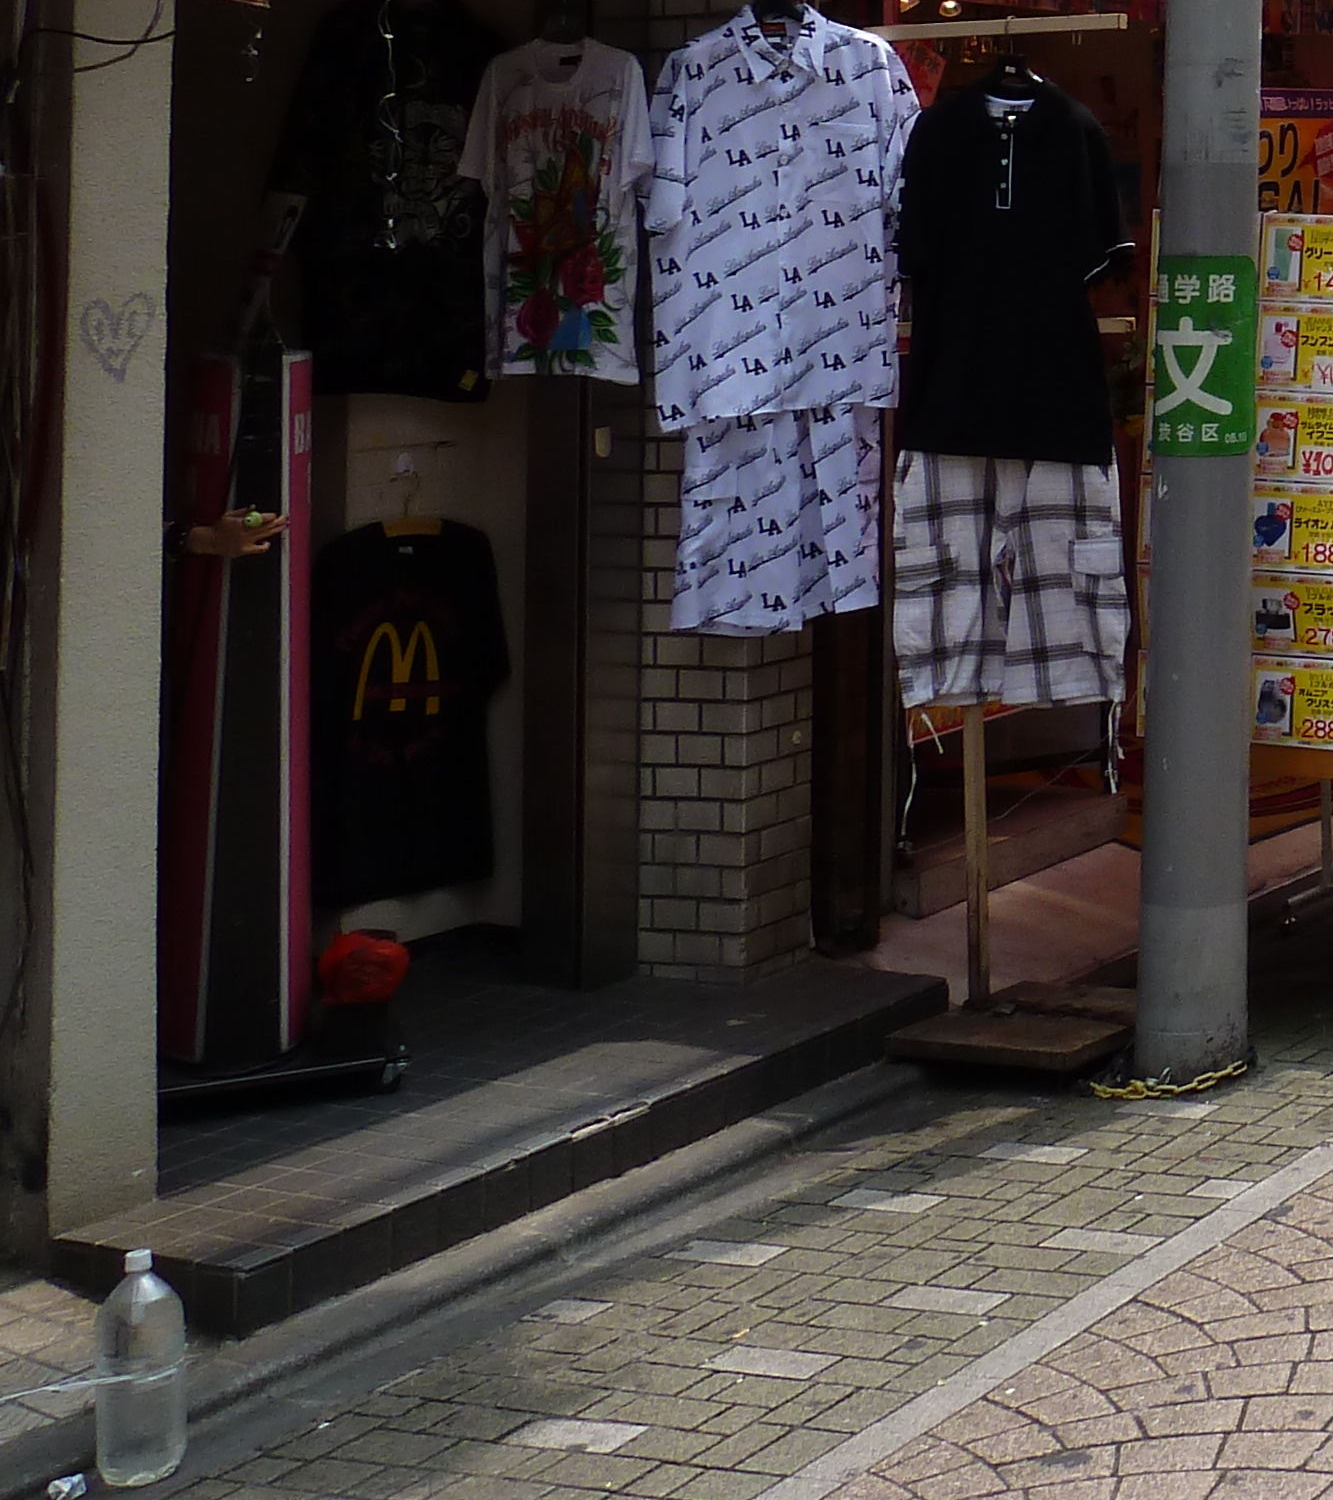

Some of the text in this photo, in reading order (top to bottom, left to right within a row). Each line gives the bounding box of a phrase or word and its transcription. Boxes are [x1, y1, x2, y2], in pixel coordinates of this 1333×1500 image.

[685, 64, 704, 81] LA
[824, 67, 845, 86] LA
[726, 149, 752, 166] LA
[856, 168, 879, 187] LA
[657, 257, 682, 275] LA
[813, 290, 837, 309] LA
[741, 357, 768, 375] LA
[1155, 316, 1233, 417] 文
[658, 403, 686, 422] LA
[1294, 518, 1329, 529] ライオン
[761, 592, 787, 611] LA
